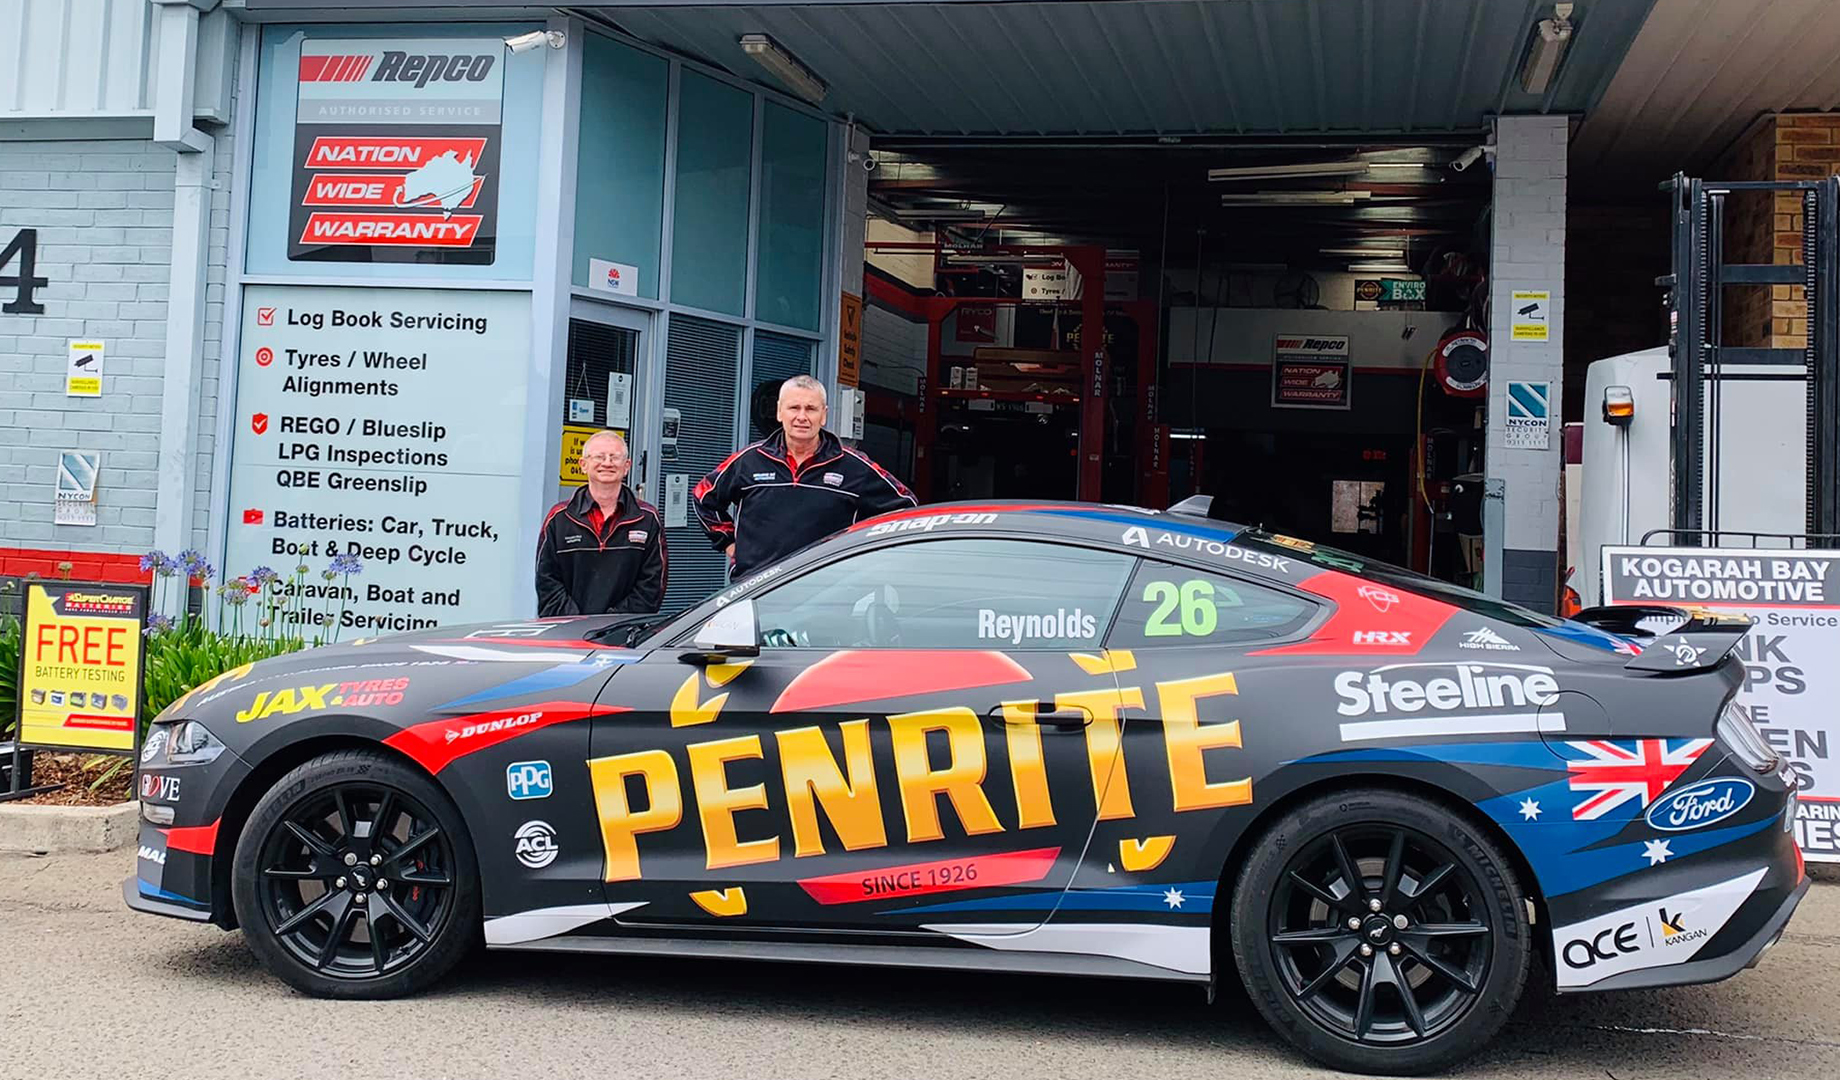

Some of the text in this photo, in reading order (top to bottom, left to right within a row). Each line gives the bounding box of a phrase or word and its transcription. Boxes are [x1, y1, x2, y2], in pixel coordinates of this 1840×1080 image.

[371, 51, 495, 88] Repco
[318, 106, 482, 116] AUTHORISED SERVICE
[316, 145, 422, 162] NATION
[316, 183, 385, 199] WIDE
[312, 221, 473, 239] WARRANTY
[1392, 281, 1427, 289] ENVIRO
[287, 309, 488, 334] Log Book Servicing
[1066, 332, 1115, 343] PETE
[1303, 339, 1345, 351] Repco
[285, 349, 341, 370] Tyres
[363, 351, 427, 370] Wheel
[1094, 352, 1103, 397] MOLNAR
[282, 376, 399, 397] Alignments
[280, 416, 340, 435] REGO
[362, 419, 446, 442] Blueslip
[1508, 419, 1547, 427] NYCON
[278, 443, 449, 466] LPG Inspections
[276, 470, 428, 496] QBE Greenslip
[58, 492, 91, 500] NYCON
[274, 511, 499, 542] Batteries: Car, Truck,
[272, 538, 467, 567] Boat & Deep Cycle
[1155, 531, 1291, 574] AUTODESK
[1621, 558, 1830, 581] KOGARAH BAY
[269, 579, 460, 606] Caravan, Boat and
[729, 565, 783, 598] AUTODESK
[1633, 580, 1825, 602] AUTOMOTIVE
[1142, 579, 1218, 638] 26
[1767, 613, 1839, 627] Service
[977, 607, 1097, 645] Reynolds
[1353, 630, 1412, 645] HRX
[36, 624, 128, 667] FREE
[1459, 641, 1521, 651] HIGH SIERRA
[35, 665, 125, 683] BATTERY TESTING
[338, 677, 410, 695] TYRES
[1334, 664, 1561, 717] Steeline
[235, 682, 339, 724] JAX
[341, 691, 405, 708] AUTO
[459, 711, 543, 739] DUNLOP
[510, 765, 551, 796] PPG
[586, 671, 1253, 884] PENRITE
[1671, 786, 1735, 827] Ford
[1796, 803, 1840, 822] ARIN
[515, 836, 559, 854] ACL
[861, 863, 979, 896] SINCE 1926
[1663, 928, 1708, 947] KANGAN
